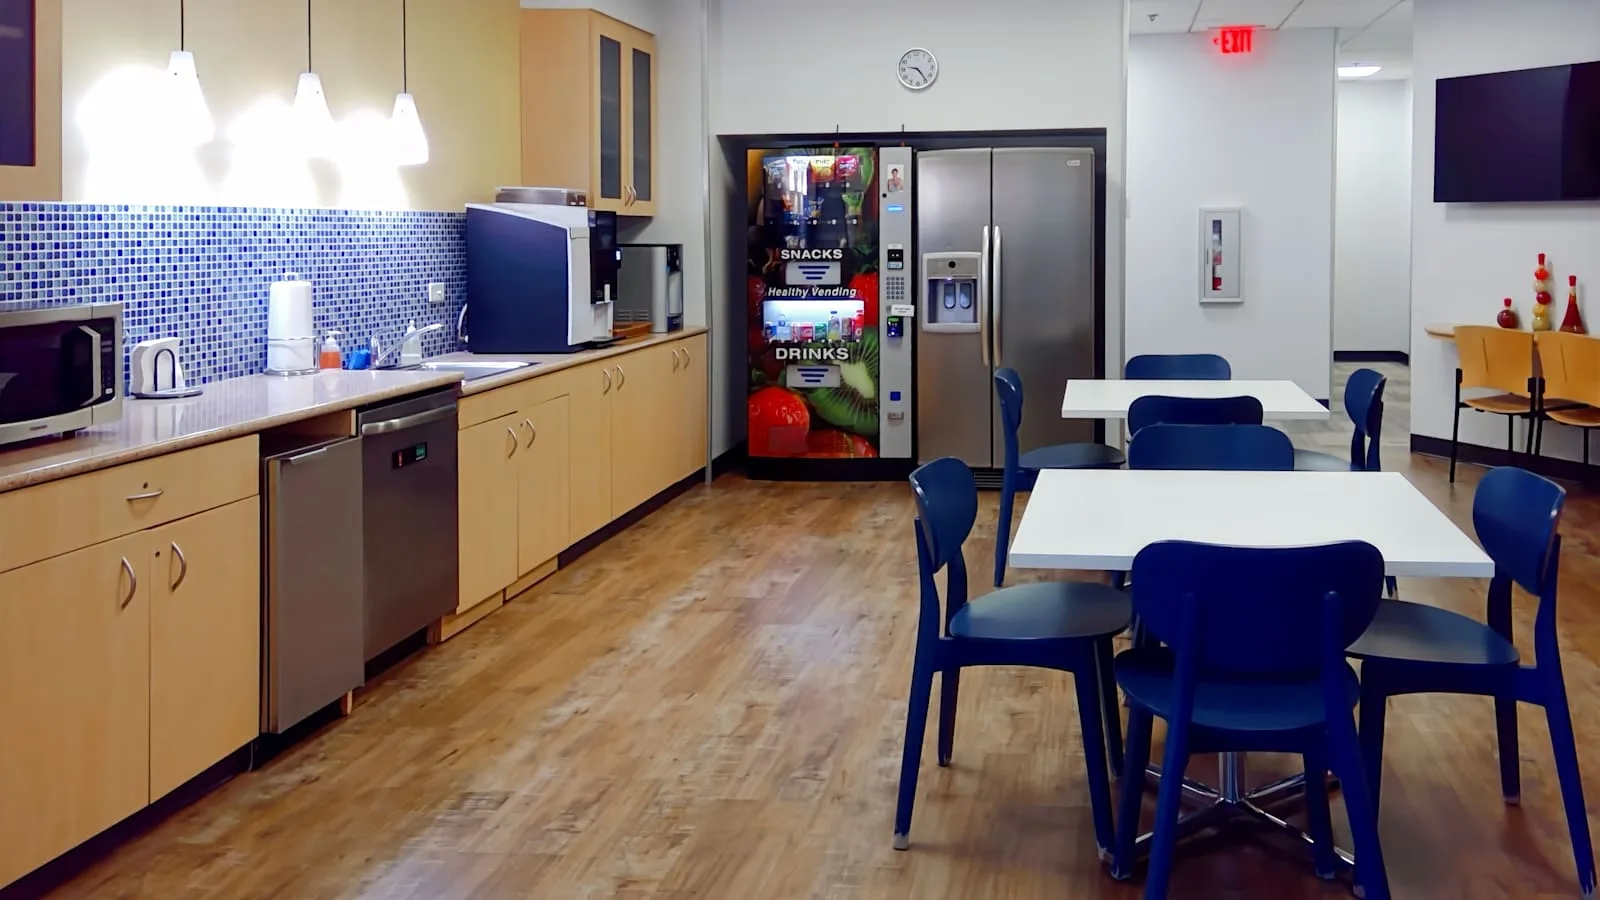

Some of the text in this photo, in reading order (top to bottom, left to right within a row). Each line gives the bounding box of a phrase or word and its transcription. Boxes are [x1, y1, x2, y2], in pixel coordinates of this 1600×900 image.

[1221, 28, 1254, 53] EXIT
[780, 249, 843, 260] SNACKS
[767, 286, 857, 299] Healthy Vending
[775, 347, 849, 360] DRINKS
